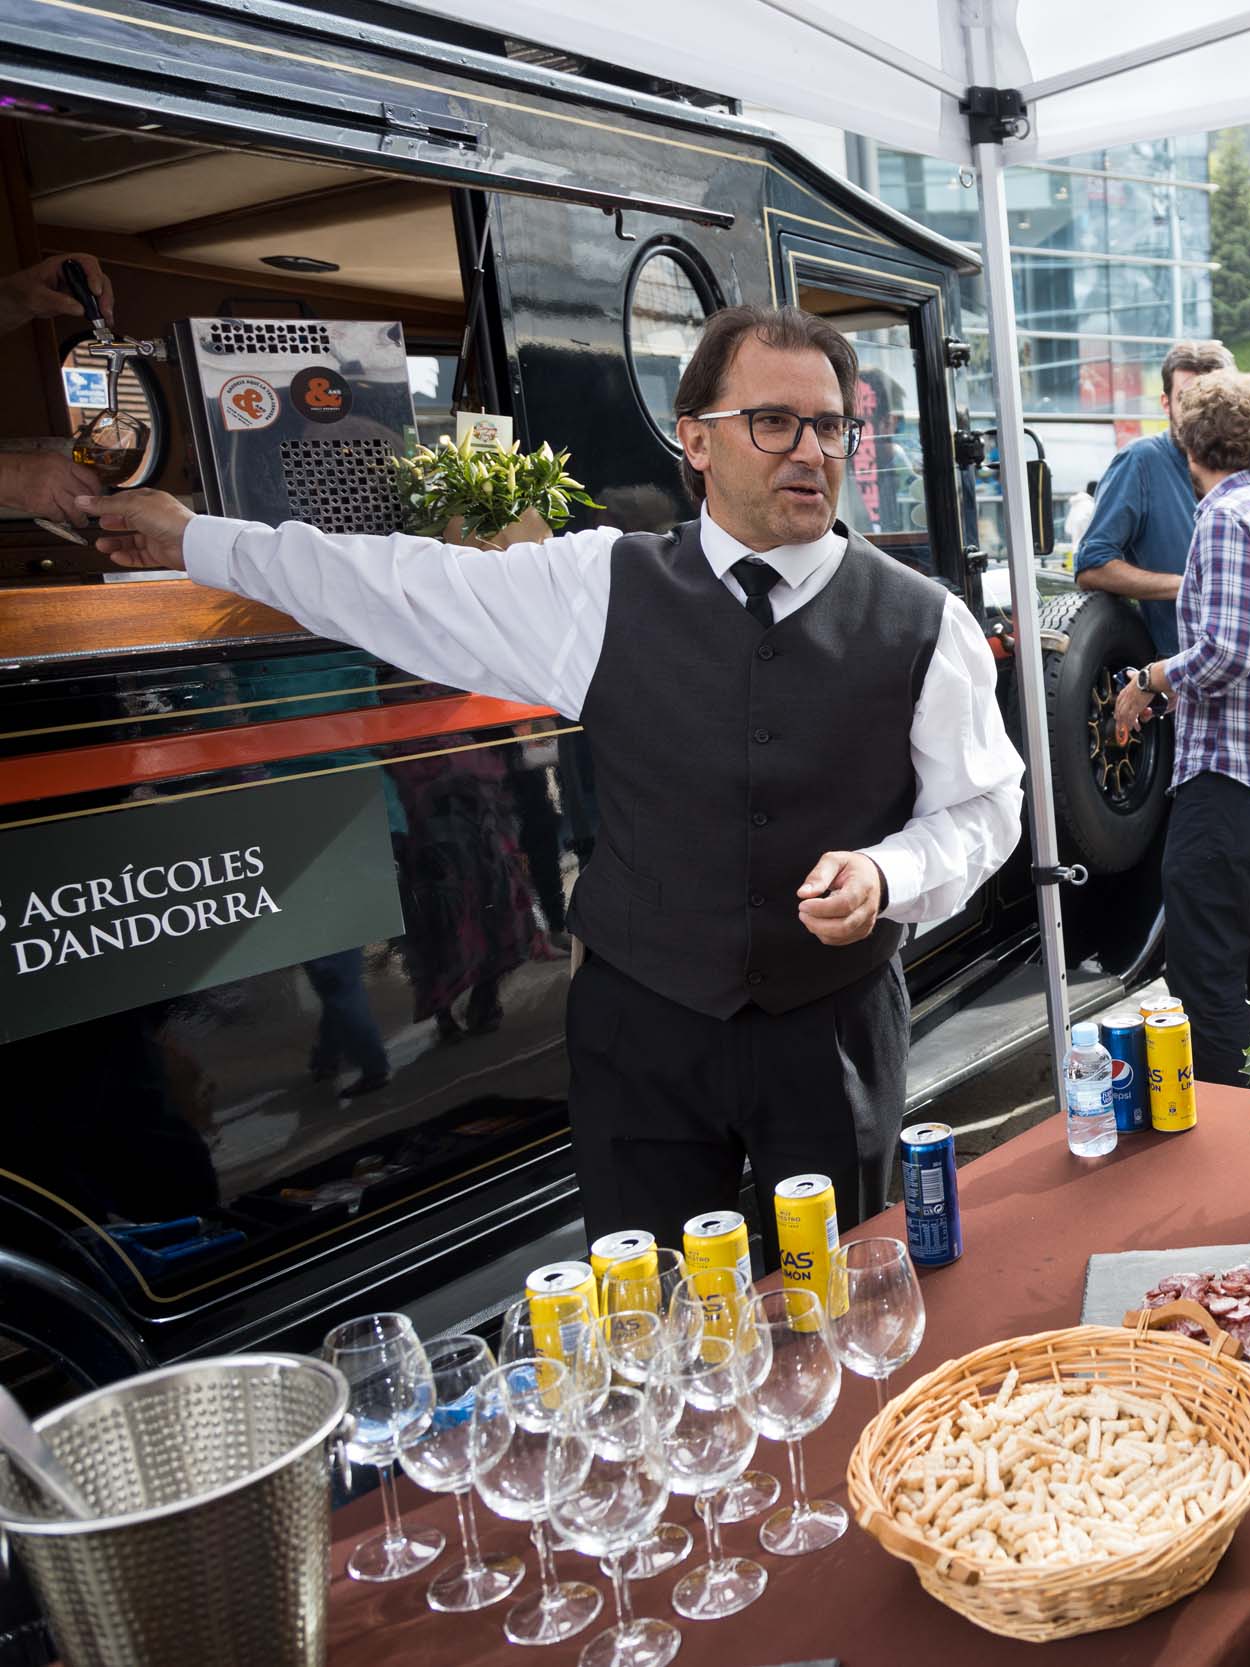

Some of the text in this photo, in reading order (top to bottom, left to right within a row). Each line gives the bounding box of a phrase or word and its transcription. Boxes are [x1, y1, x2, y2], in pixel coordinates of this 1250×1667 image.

[19, 845, 265, 928] AGRÍCOLES
[11, 886, 282, 974] D'ANDORRA
[1112, 1091, 1132, 1101] epsi
